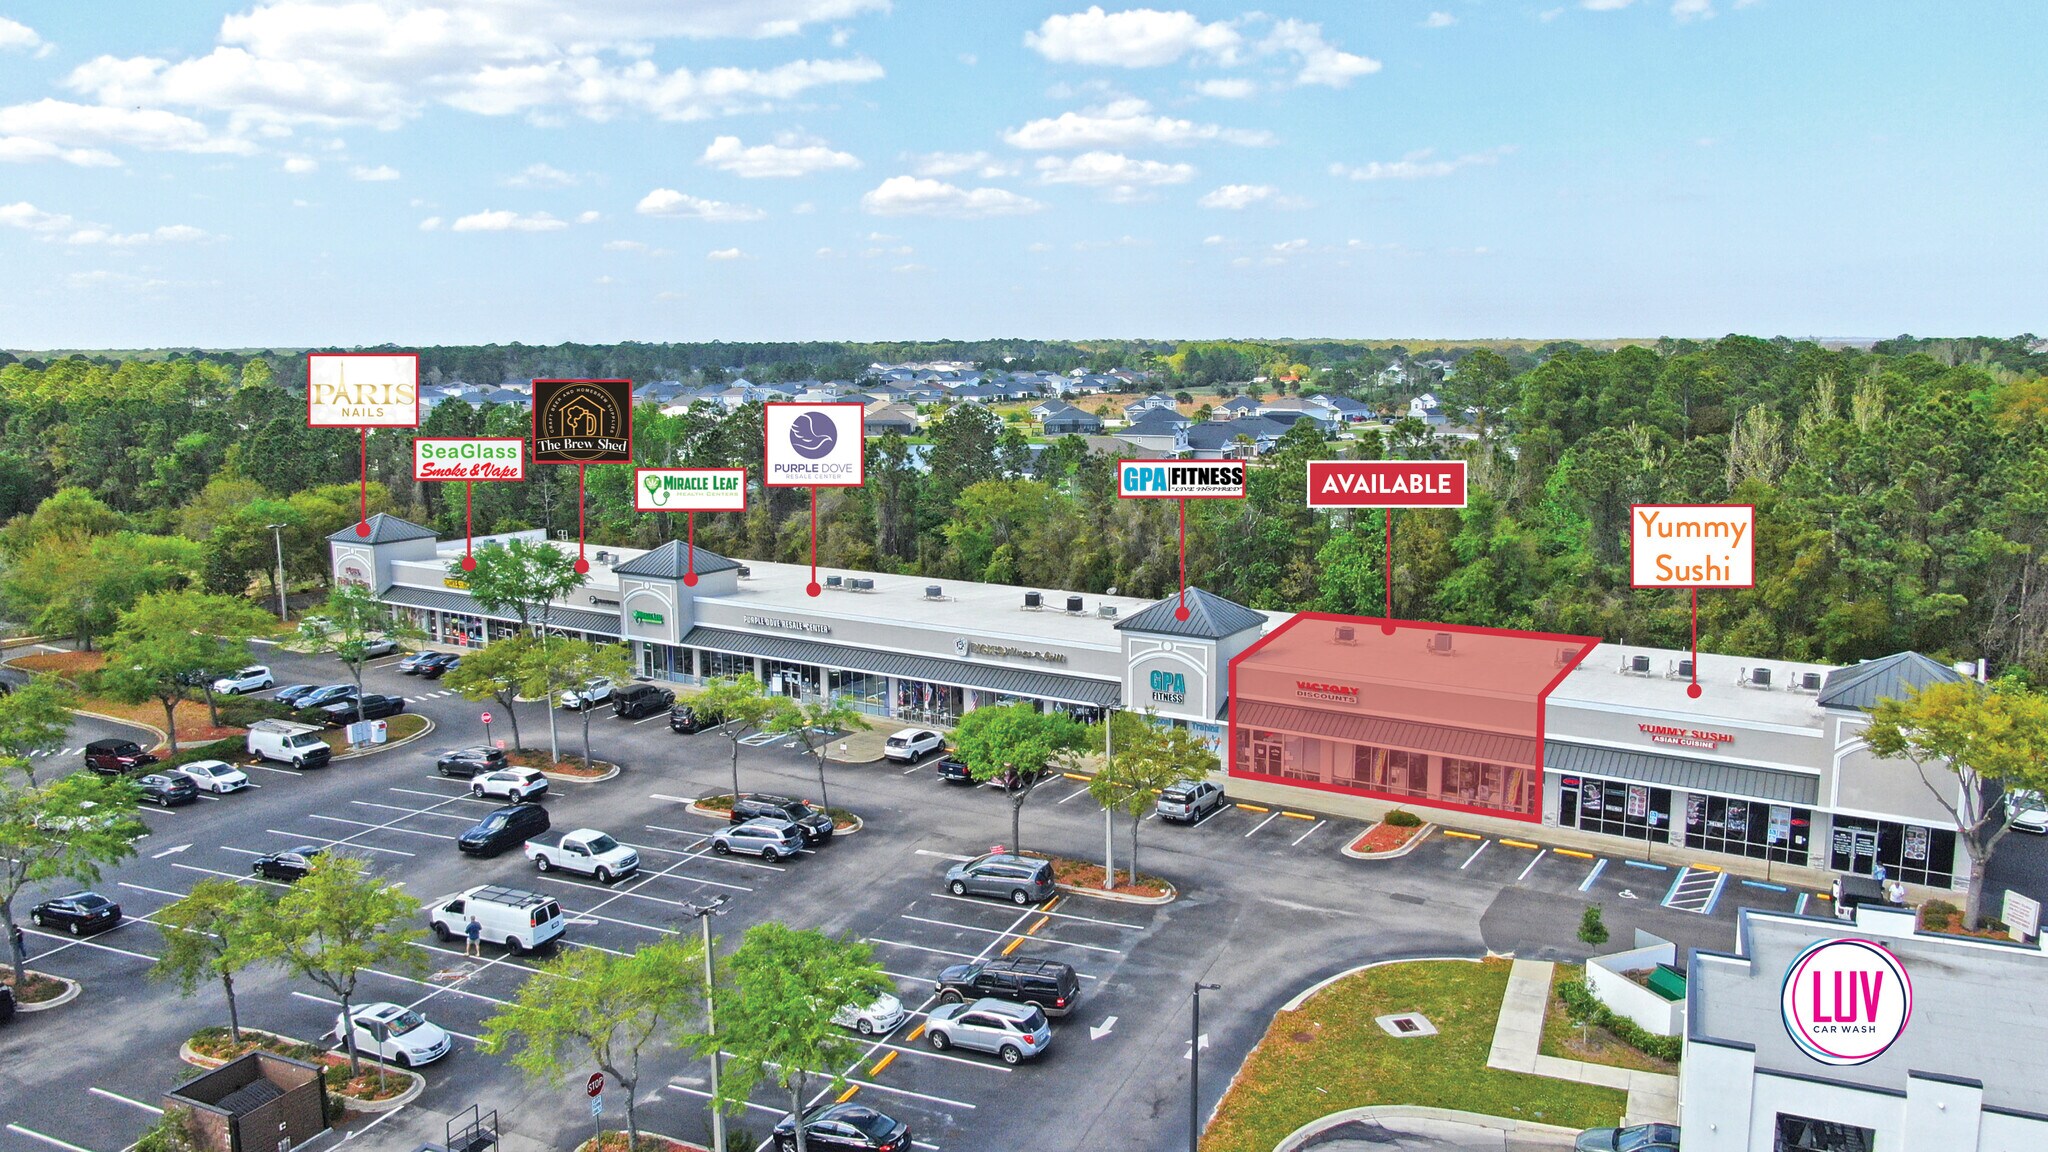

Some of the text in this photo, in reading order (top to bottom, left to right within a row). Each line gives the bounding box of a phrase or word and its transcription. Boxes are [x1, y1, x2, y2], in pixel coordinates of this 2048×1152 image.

[743, 615, 764, 626] PURPLE
[765, 618, 781, 628] DOVE
[781, 620, 803, 630] RESALE
[1150, 670, 1186, 694] GPA
[1296, 681, 1360, 696] VICTORY
[1152, 691, 1184, 704] FITNESS
[1296, 690, 1356, 703] DISCOUNTS
[1637, 723, 1734, 743] YUMMY SUSHI
[1653, 735, 1715, 749] ASIAN CUISINE
[588, 1076, 603, 1092] STOP
